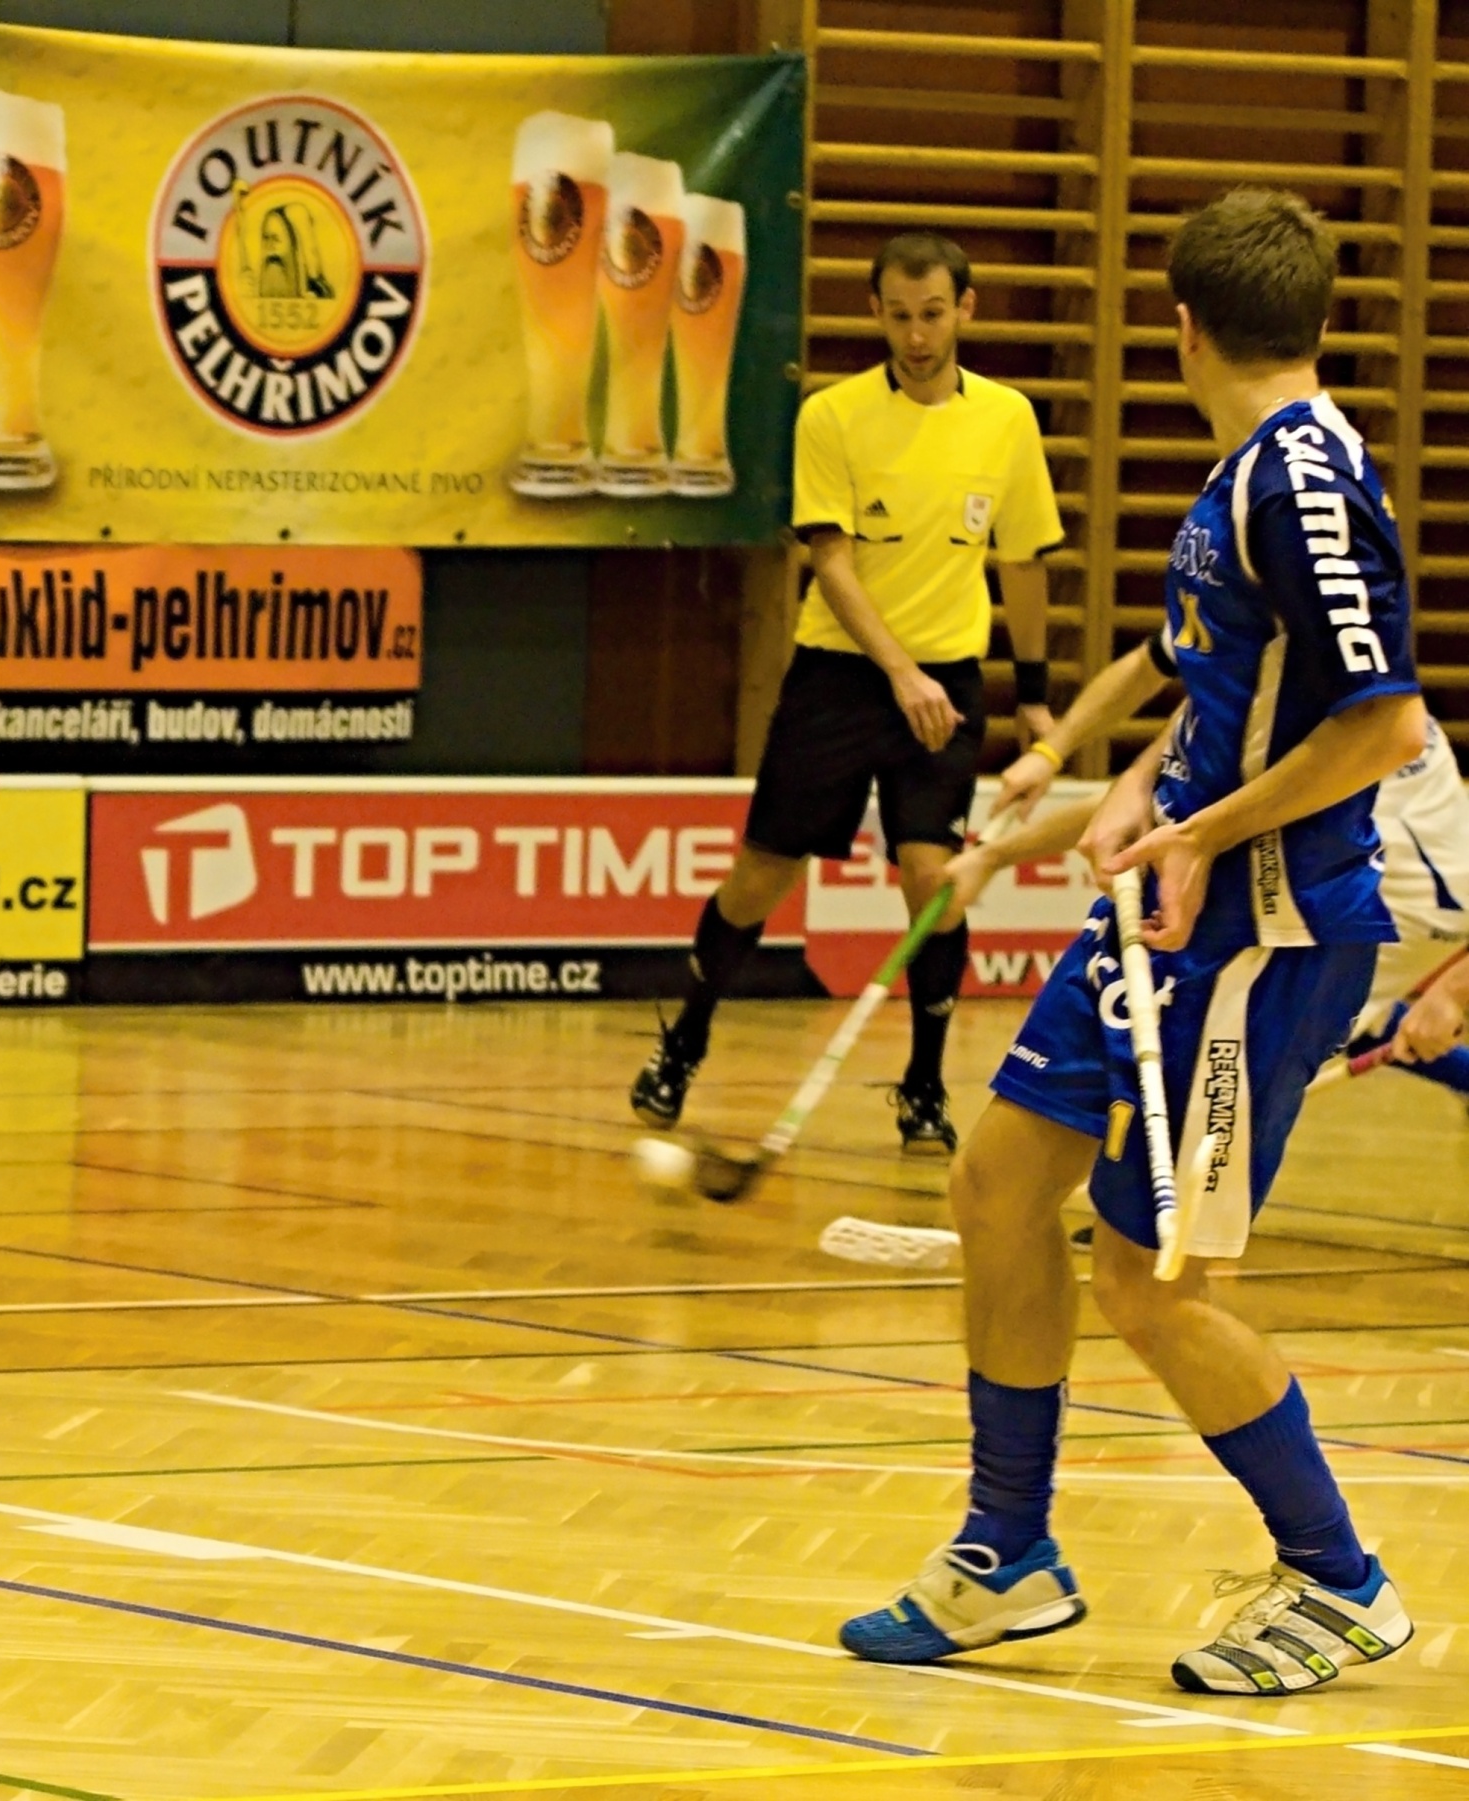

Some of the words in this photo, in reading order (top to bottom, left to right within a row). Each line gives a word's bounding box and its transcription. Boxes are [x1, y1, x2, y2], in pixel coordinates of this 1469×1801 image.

[173, 118, 405, 247] POUTNÍK
[167, 273, 411, 424] PELHŘIMOV
[89, 461, 198, 488] PŘÍRODNÍ
[207, 464, 422, 493] NEPASTERIZOVANÉ
[430, 472, 484, 495] PIVO
[1274, 424, 1390, 674] SALMING
[145, 700, 246, 746] budov,
[271, 826, 479, 898] TOP
[494, 827, 735, 897] TIME
[302, 955, 601, 1001] www.toptime.cz
